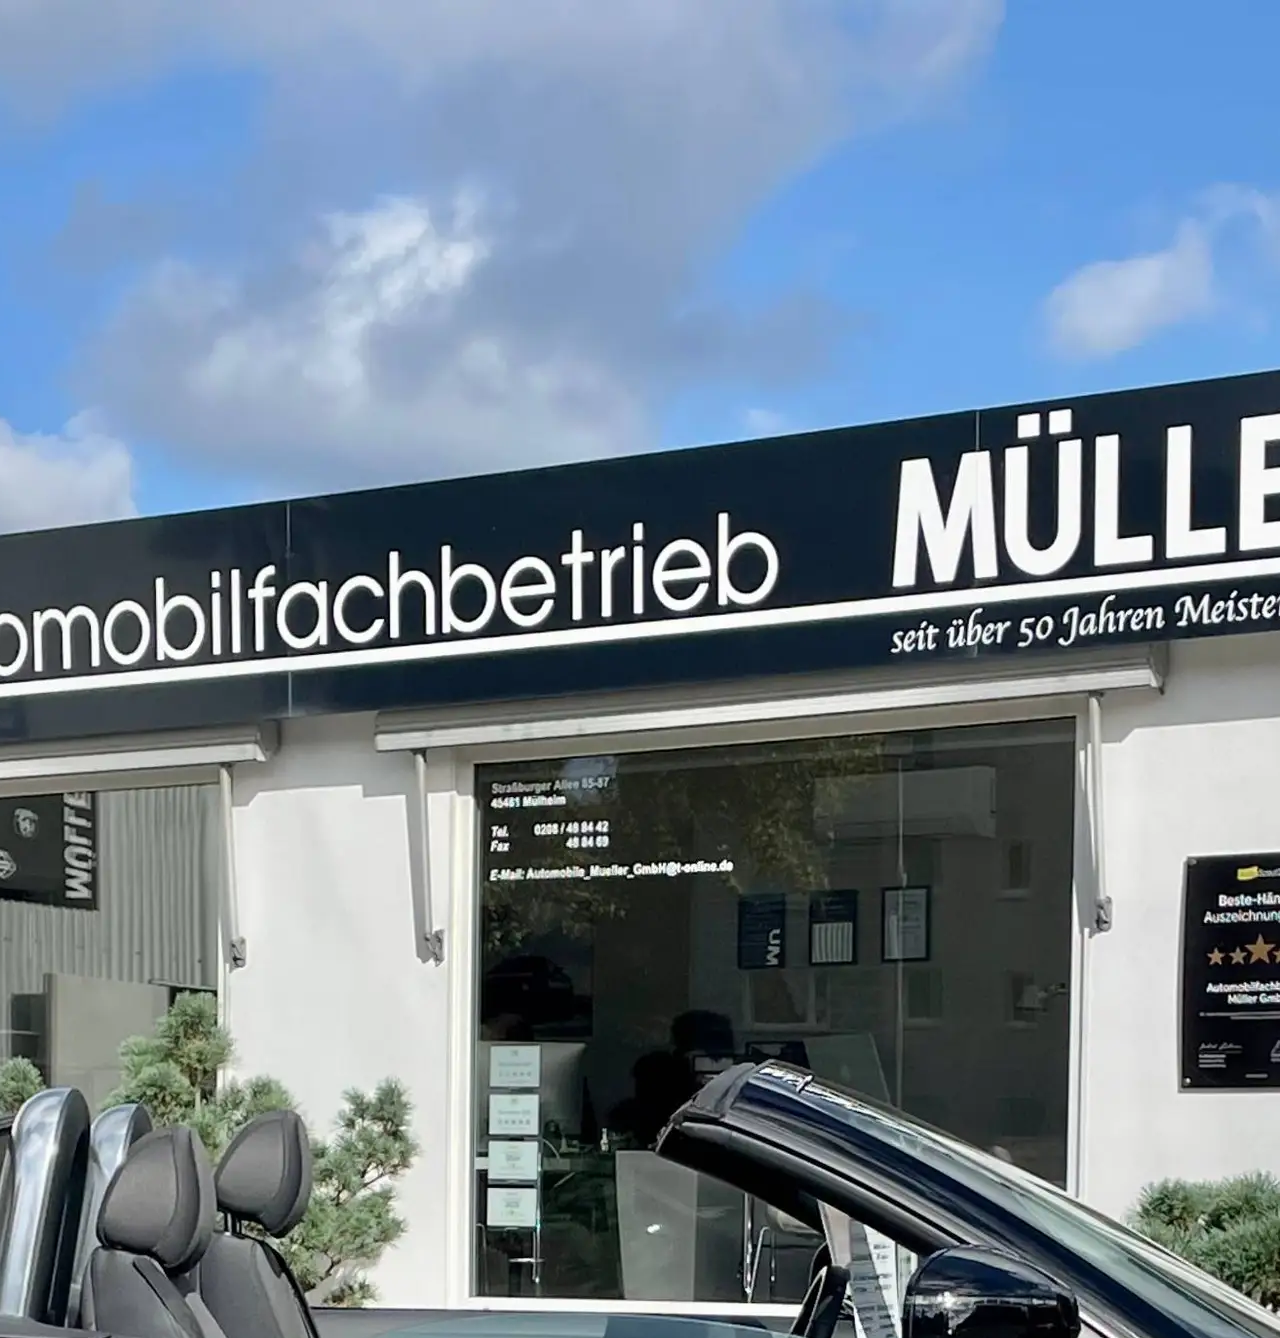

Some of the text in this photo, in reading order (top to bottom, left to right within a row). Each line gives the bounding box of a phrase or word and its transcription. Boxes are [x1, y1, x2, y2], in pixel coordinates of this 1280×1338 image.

[890, 618, 939, 653] seit
[945, 608, 1010, 648] über
[1018, 616, 1055, 648] 50
[1057, 595, 1165, 648] Jahren
[491, 825, 509, 838] Tel.
[595, 820, 609, 833] 42
[490, 840, 510, 852] Fax
[1227, 993, 1257, 1004] Müller
